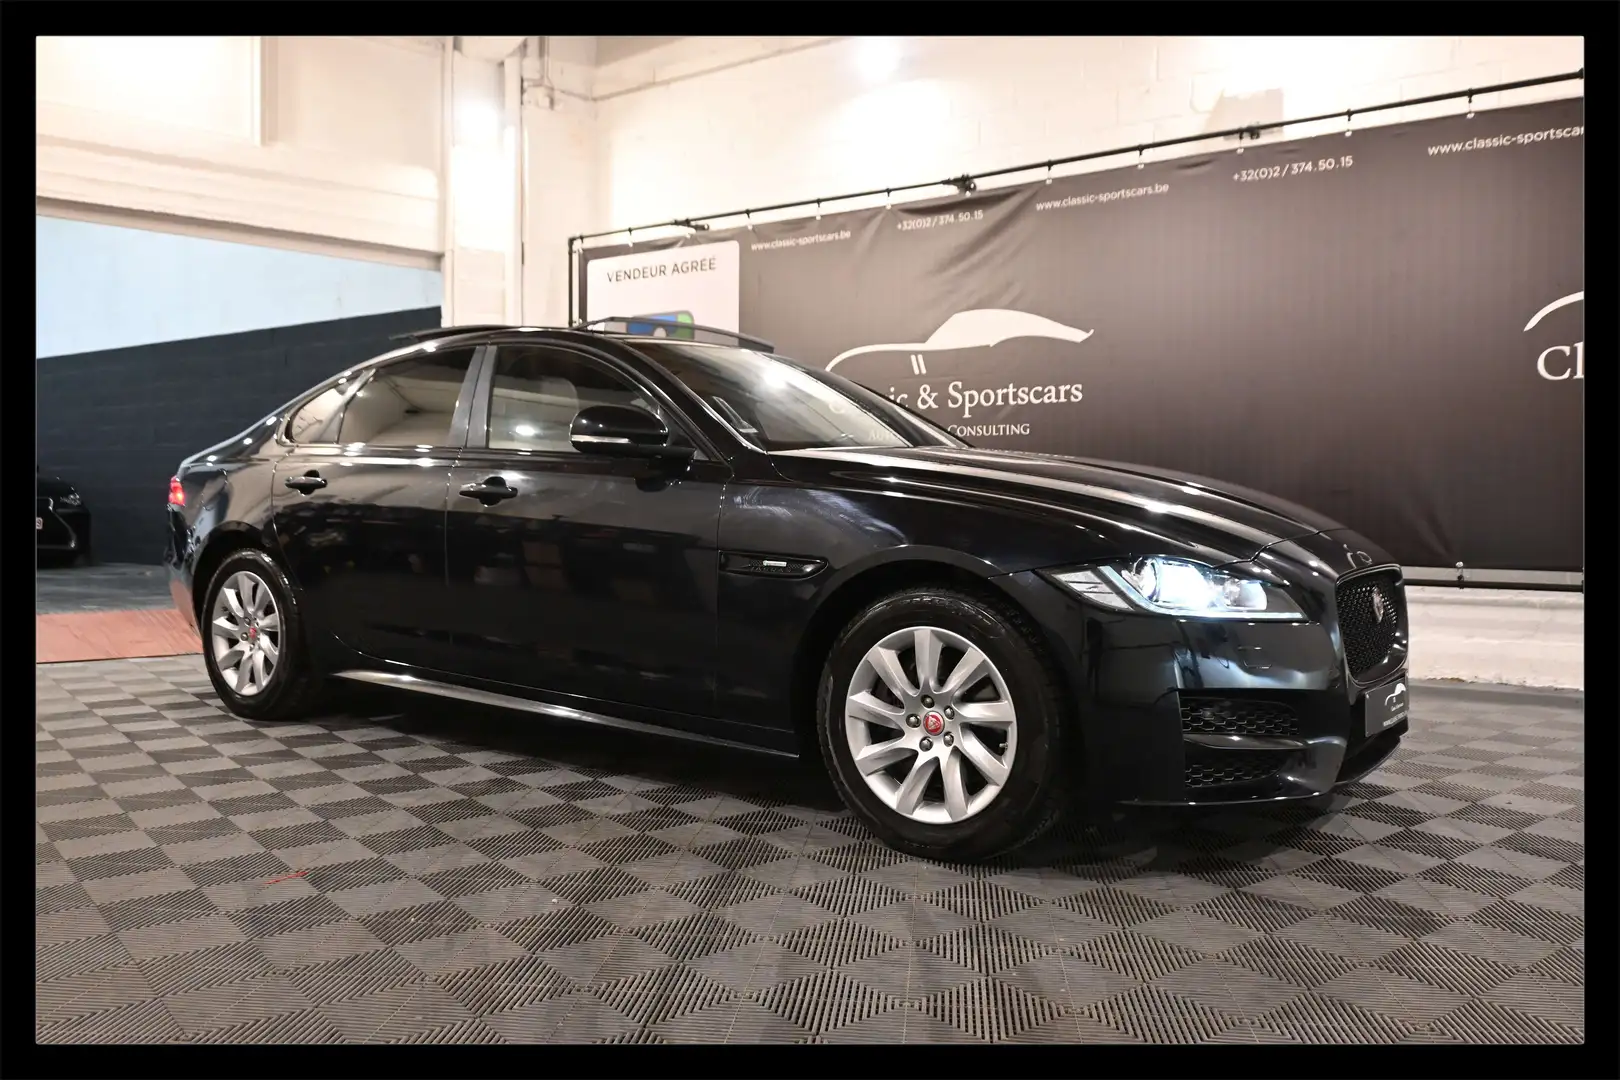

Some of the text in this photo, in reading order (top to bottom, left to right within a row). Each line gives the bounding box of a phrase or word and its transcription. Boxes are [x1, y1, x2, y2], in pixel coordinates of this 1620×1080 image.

[1036, 183, 1169, 211] www.classic-sportscars.be
[751, 230, 851, 251] www.classic-sportscars.be
[607, 264, 667, 283] VENDEUR
[917, 384, 939, 409] &
[947, 380, 1083, 418] Sportscars
